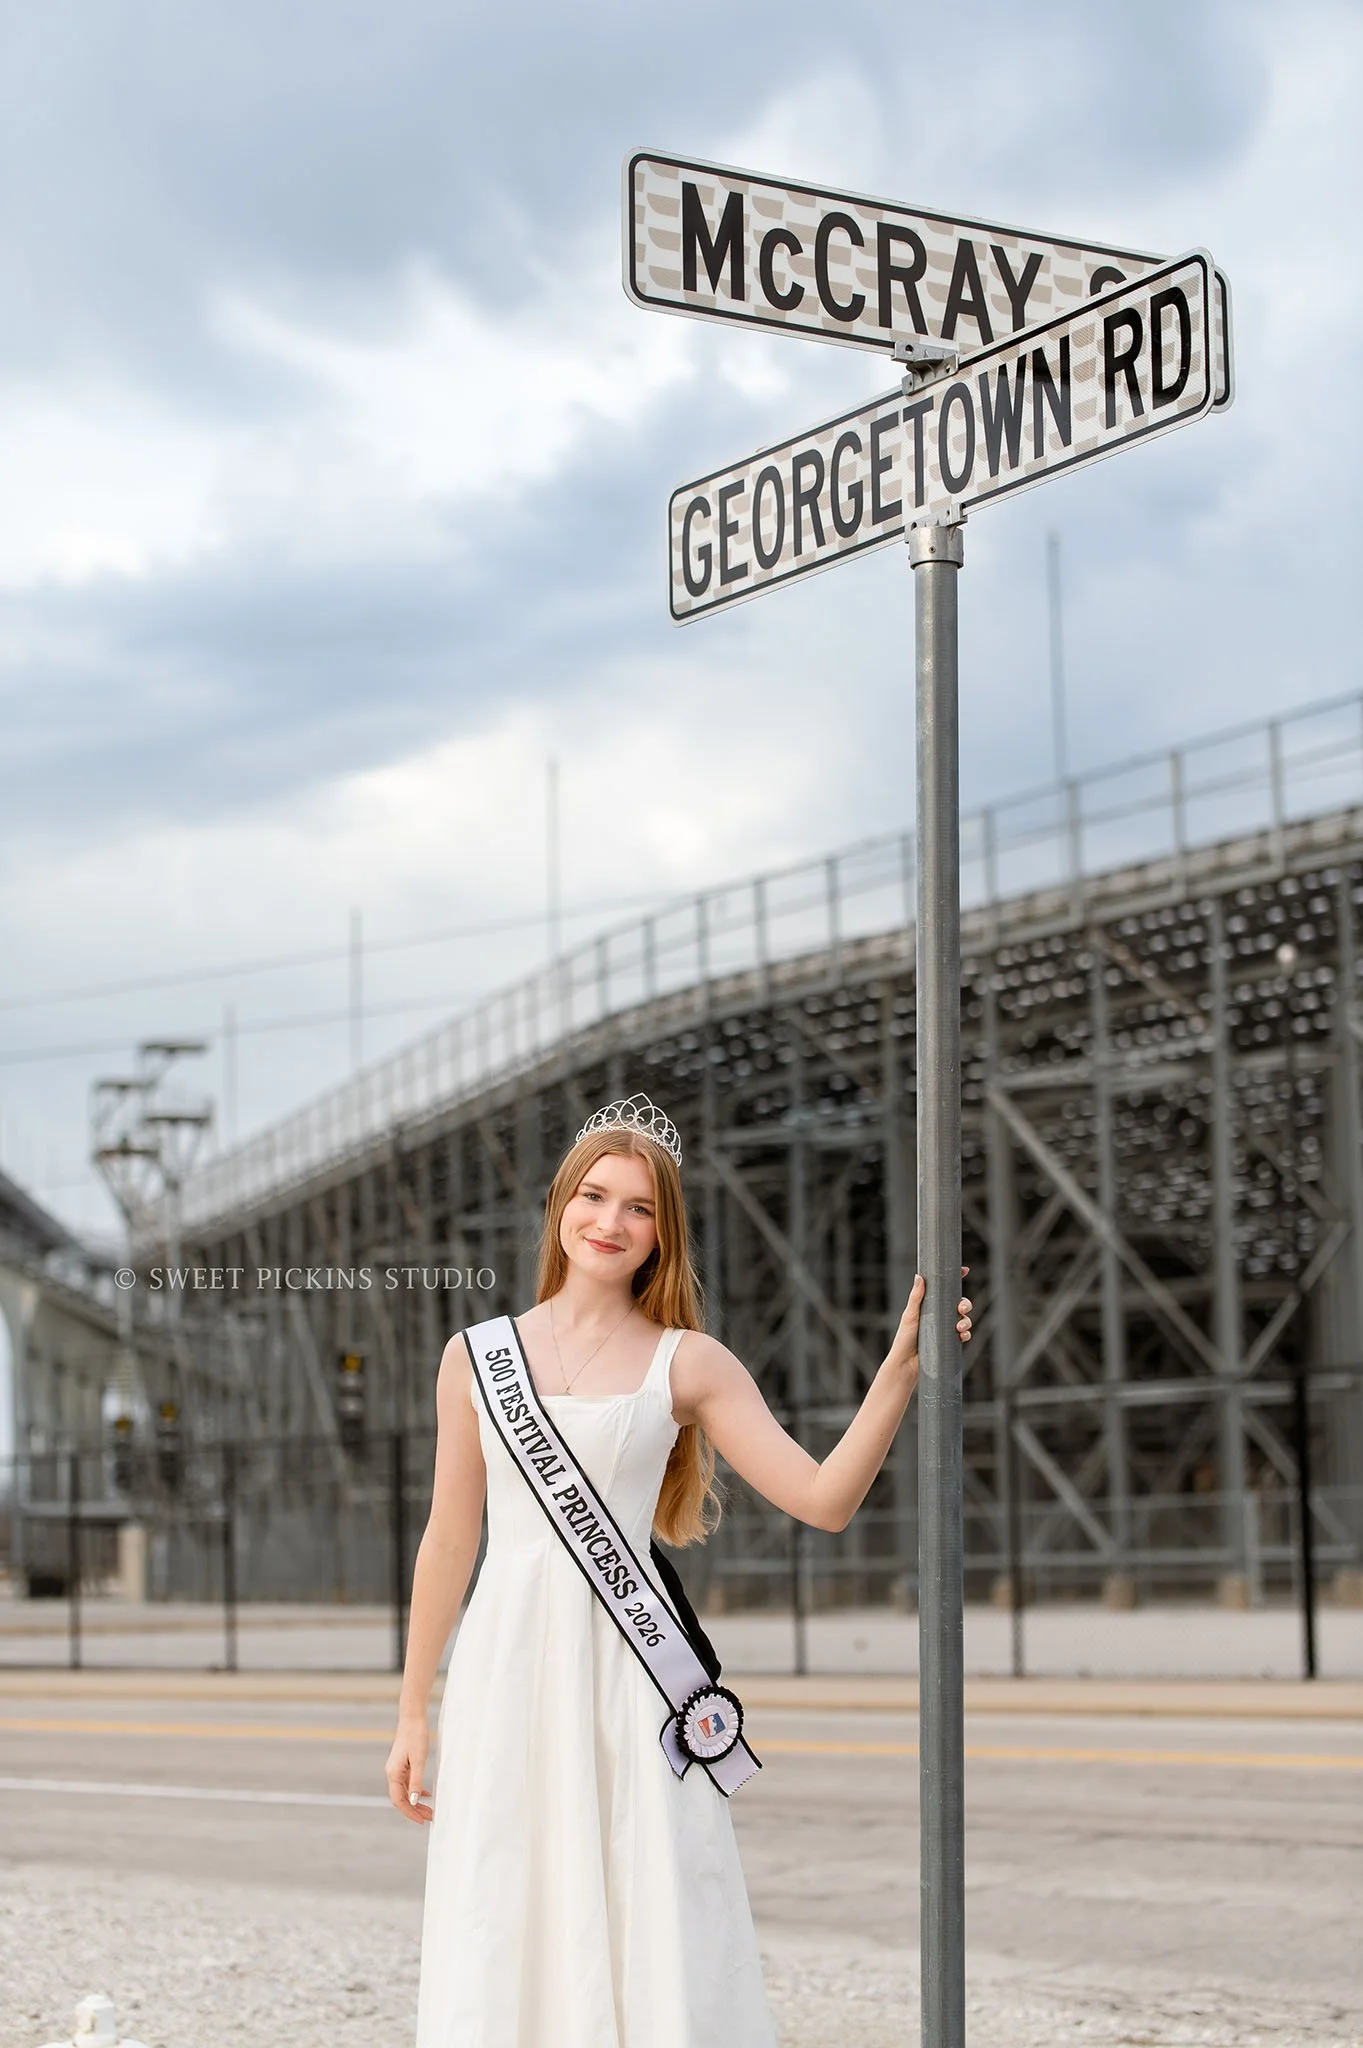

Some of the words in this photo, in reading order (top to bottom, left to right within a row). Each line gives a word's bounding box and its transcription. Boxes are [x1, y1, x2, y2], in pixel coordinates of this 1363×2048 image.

[681, 181, 1044, 346] McCRAY
[682, 337, 1072, 598] GEORGETOWN
[1104, 286, 1192, 430] RD
[485, 1347, 516, 1383] 500
[495, 1382, 567, 1486] FESTIVAL
[552, 1484, 639, 1601] PRINCESS
[624, 1601, 666, 1648] 2026
